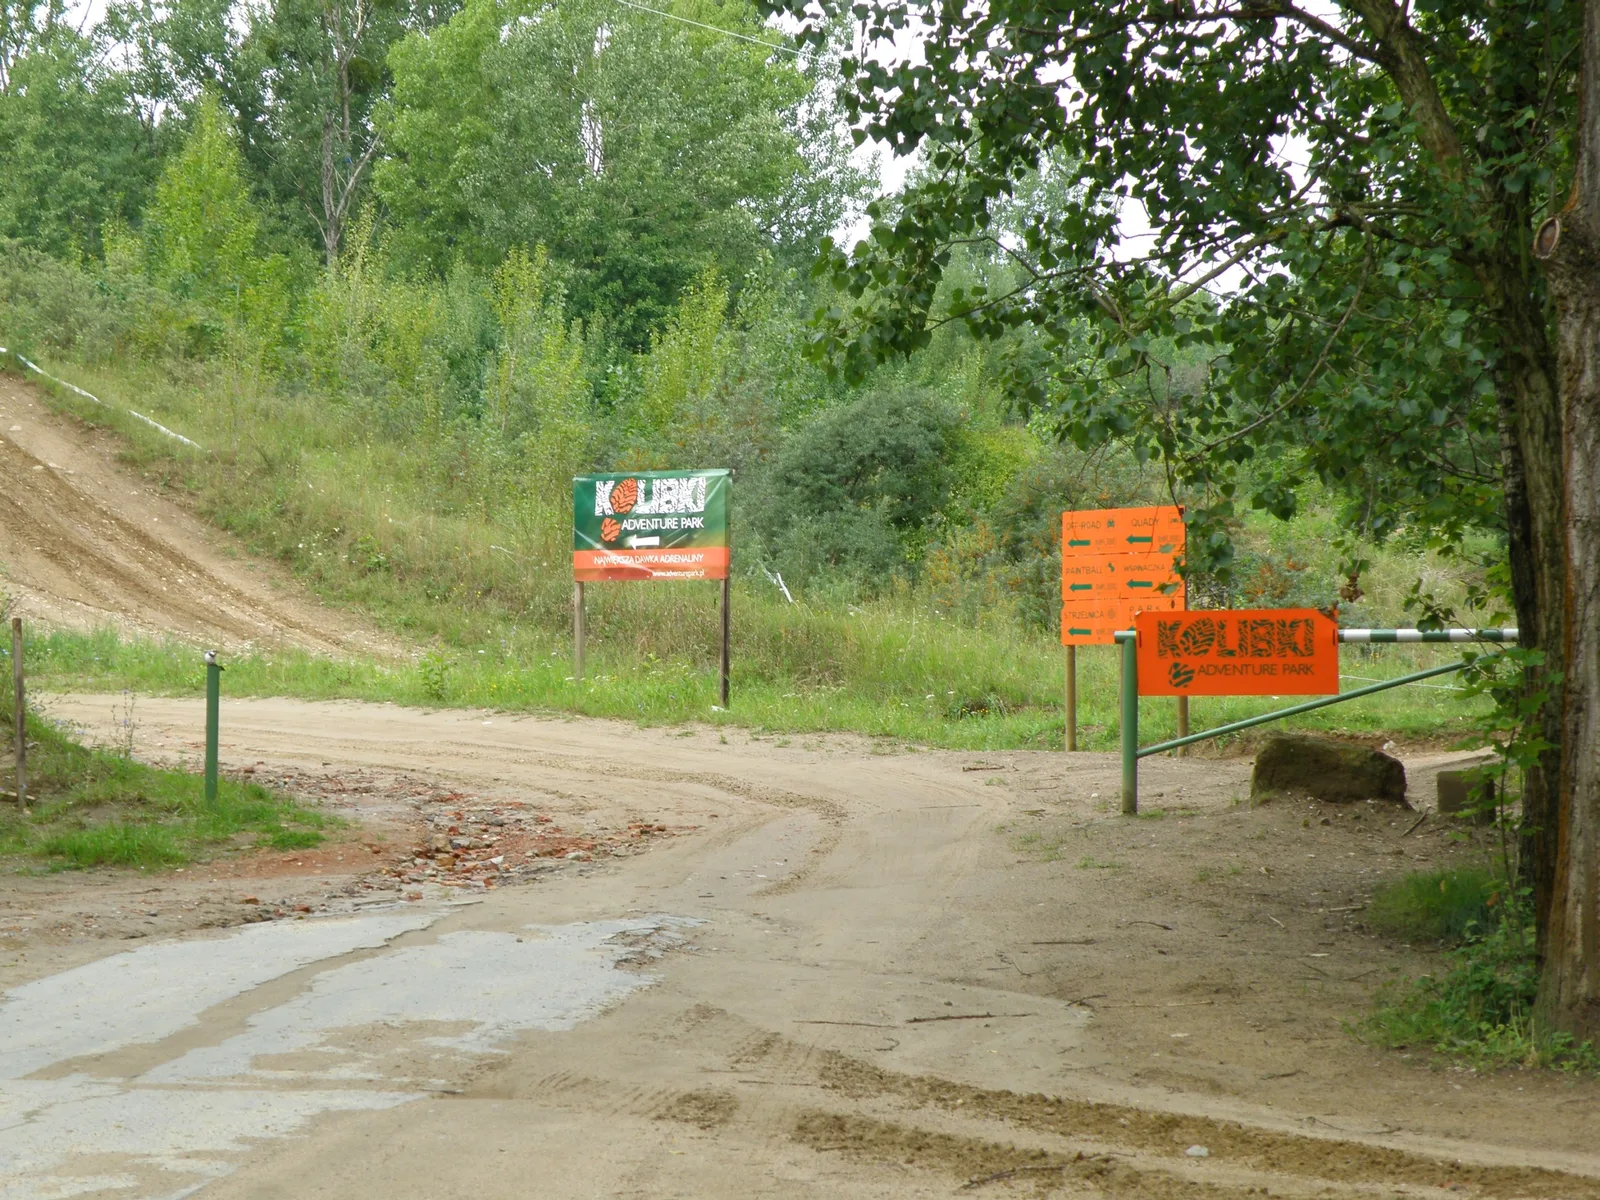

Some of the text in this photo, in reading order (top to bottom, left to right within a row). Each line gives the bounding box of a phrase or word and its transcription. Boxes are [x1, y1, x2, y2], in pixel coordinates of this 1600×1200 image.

[595, 477, 706, 516] KOLIBKI
[621, 517, 704, 530] ADVENTURE PARK
[1066, 521, 1102, 530] OFF-ROAD
[1131, 518, 1160, 527] QUADY
[635, 555, 658, 564] DAWKA
[660, 554, 704, 563] ADRENALINY
[1064, 611, 1104, 619] STRZELNICA
[1158, 618, 1314, 657] KOLIBKI
[1198, 664, 1314, 676] ADVENTURE PARK
